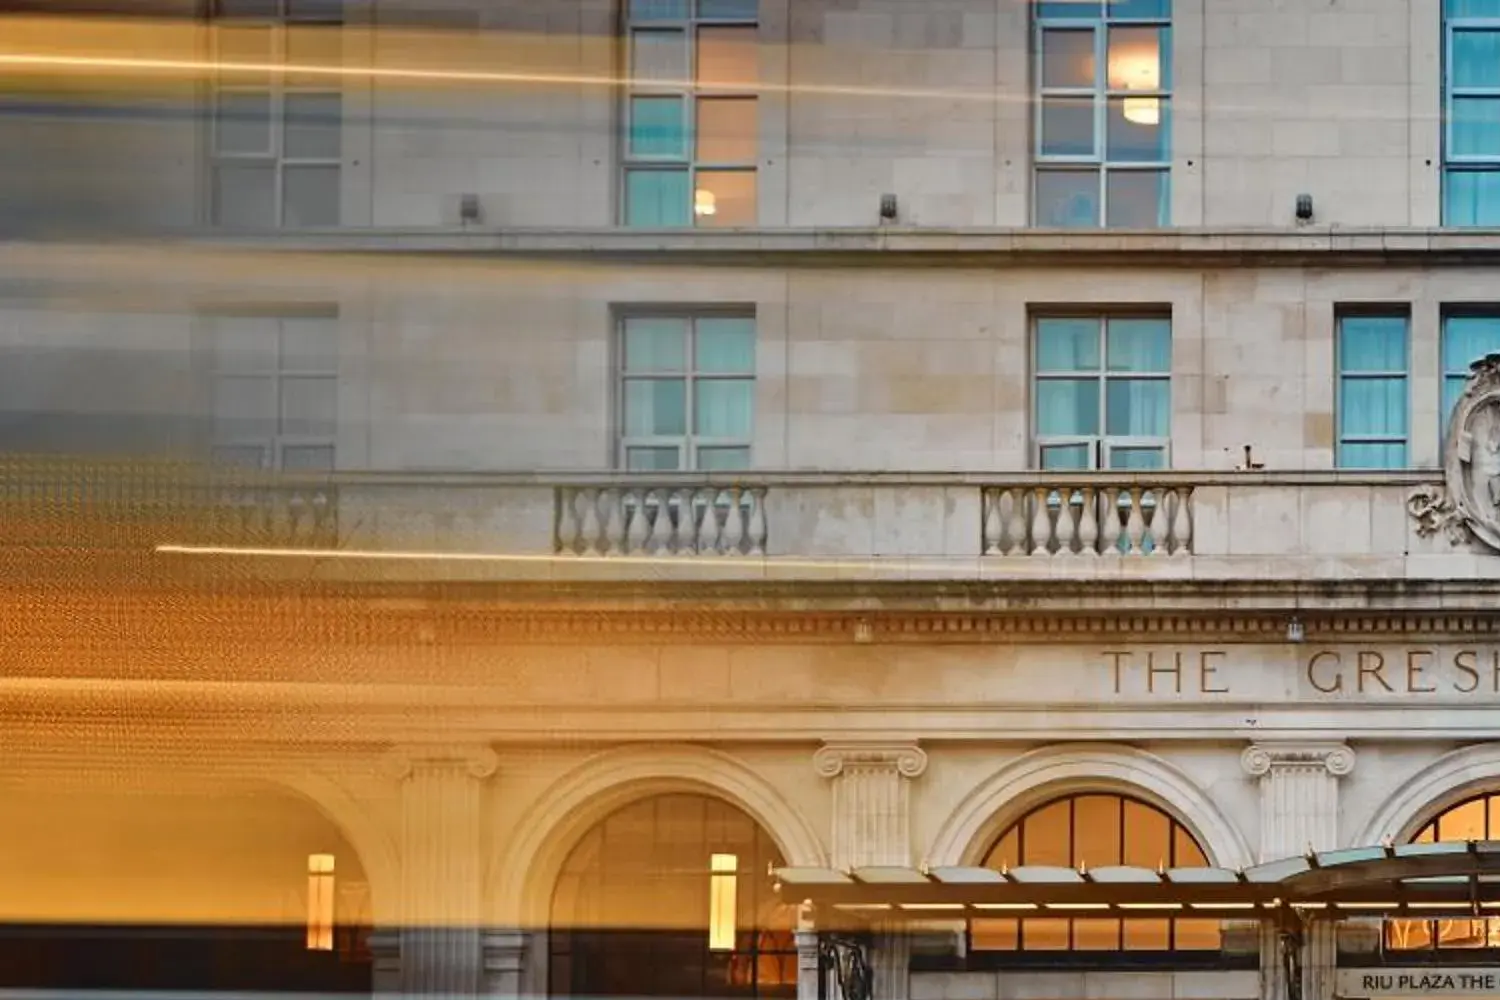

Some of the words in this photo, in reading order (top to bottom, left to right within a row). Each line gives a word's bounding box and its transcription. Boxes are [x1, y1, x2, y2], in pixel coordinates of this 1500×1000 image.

[1101, 651, 1229, 693] THE
[1362, 974, 1393, 990] RIU
[1399, 974, 1454, 990] PLAZA
[1459, 974, 1495, 990] THE
